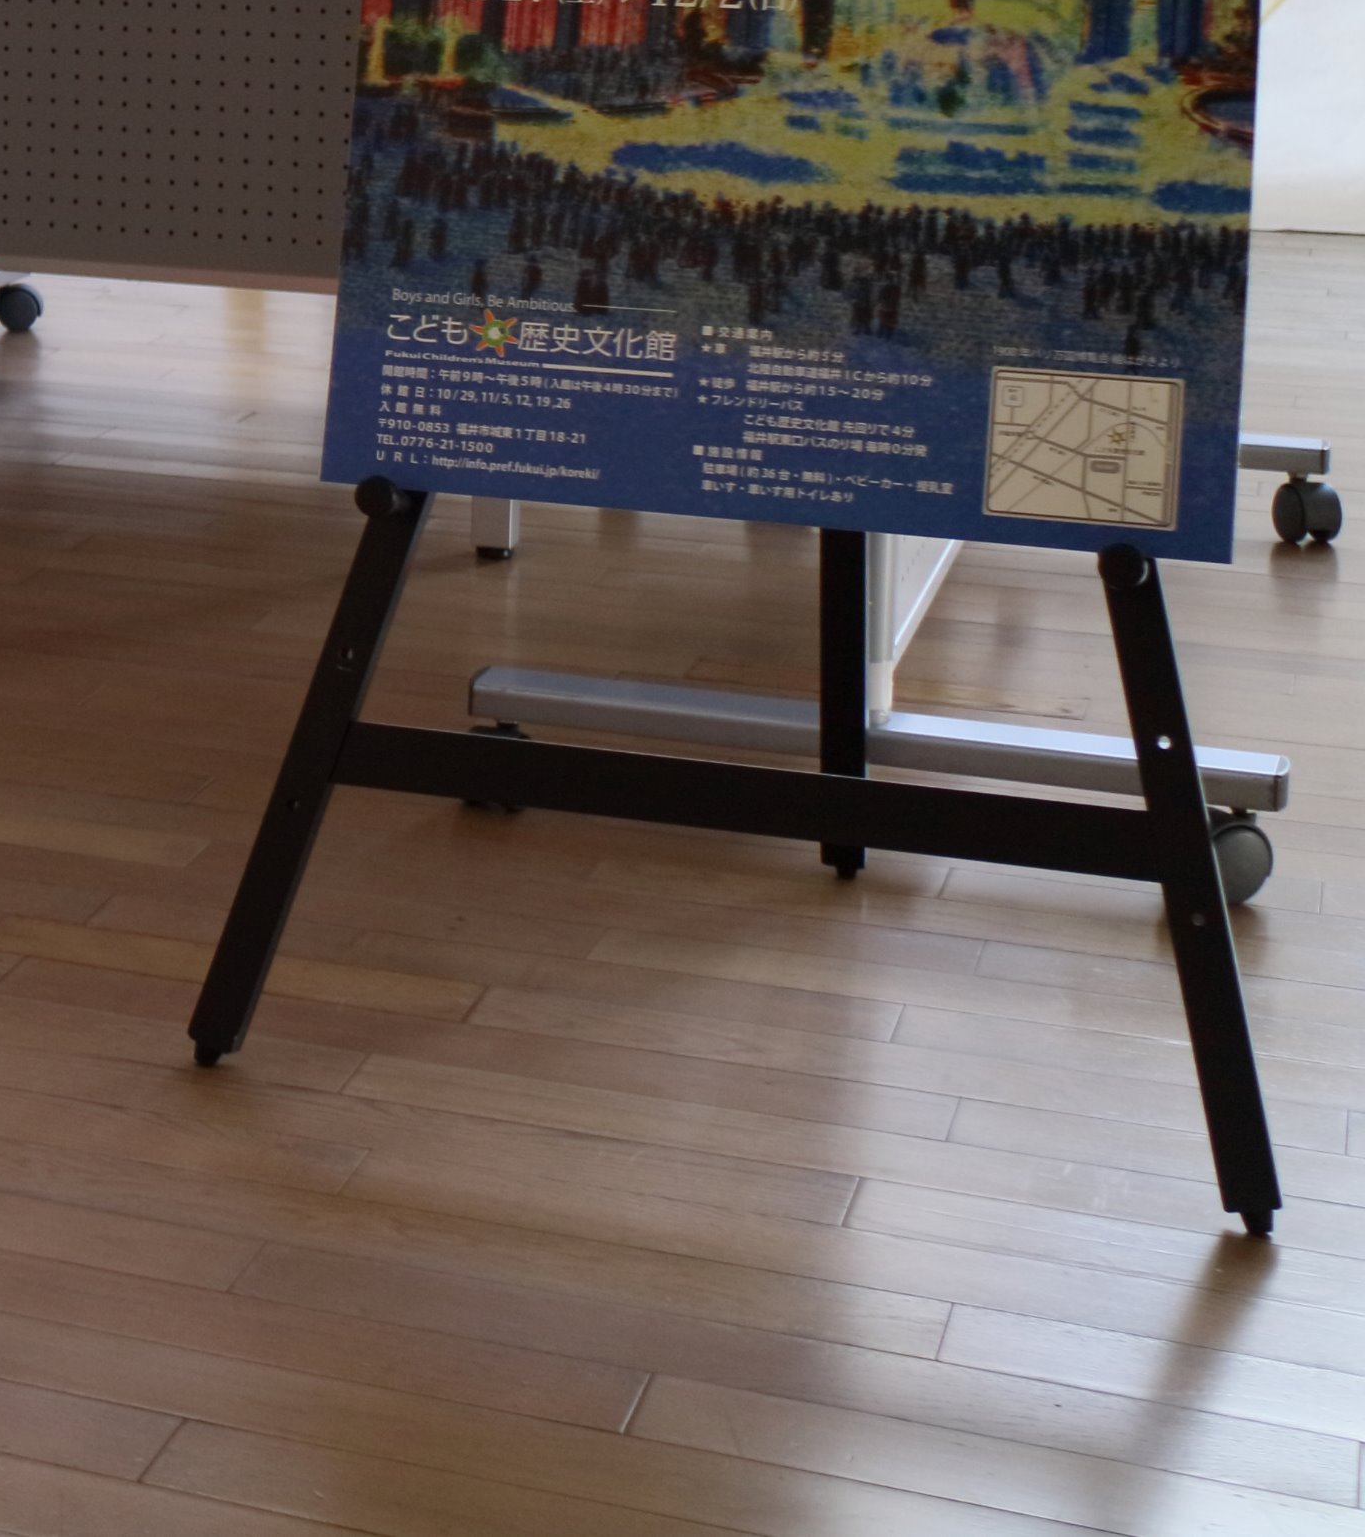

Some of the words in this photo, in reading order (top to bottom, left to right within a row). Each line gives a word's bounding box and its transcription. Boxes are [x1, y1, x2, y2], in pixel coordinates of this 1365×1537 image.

[391, 288, 422, 305] Boys
[424, 290, 450, 304] and
[452, 292, 485, 308] Girls,
[487, 294, 504, 308] Be
[387, 311, 469, 345] こども
[517, 320, 677, 362] 歴史文化館
[385, 350, 422, 360] Fukui
[484, 357, 540, 369] Museum
[711, 395, 805, 410] フレンドリーバス
